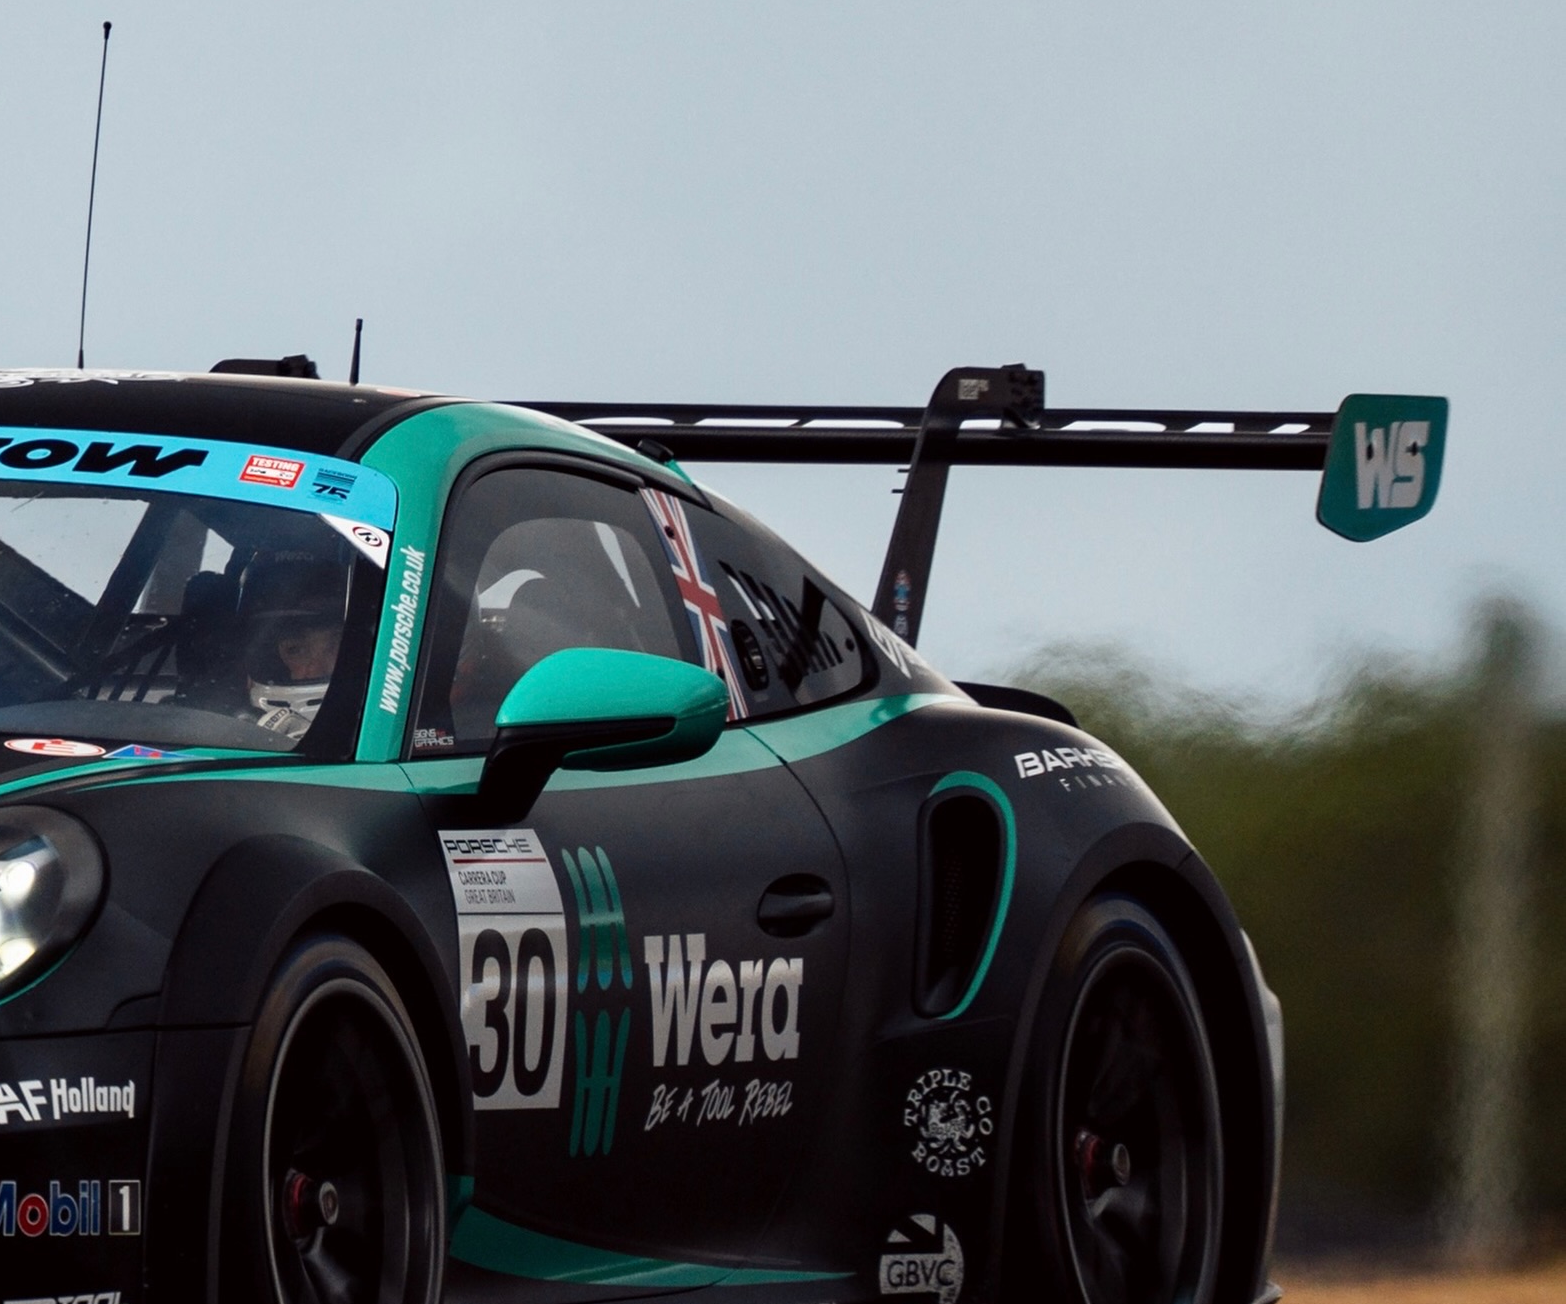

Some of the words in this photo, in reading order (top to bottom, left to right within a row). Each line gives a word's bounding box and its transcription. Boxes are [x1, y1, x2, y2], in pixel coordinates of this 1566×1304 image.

[251, 457, 299, 472] TESTING
[1354, 420, 1431, 510] WS
[380, 545, 425, 715] www.porsche.co.uk
[443, 839, 532, 855] PORSCHE
[458, 871, 492, 885] CARRERA
[492, 871, 507, 885] CUP
[464, 889, 486, 904] GREAT
[487, 889, 516, 904] BRITAIN
[470, 928, 556, 1097] 30
[644, 933, 804, 1067] Wera
[50, 1076, 136, 1120] Holland
[644, 1083, 679, 1131] BE
[677, 1087, 694, 1122] A
[696, 1079, 735, 1127] TOOL
[738, 1078, 793, 1126] REBEL
[904, 1069, 972, 1126] TRIPLE
[976, 1096, 994, 1135] CO
[911, 1141, 986, 1178] ROAST
[887, 1260, 955, 1287] GBVC
